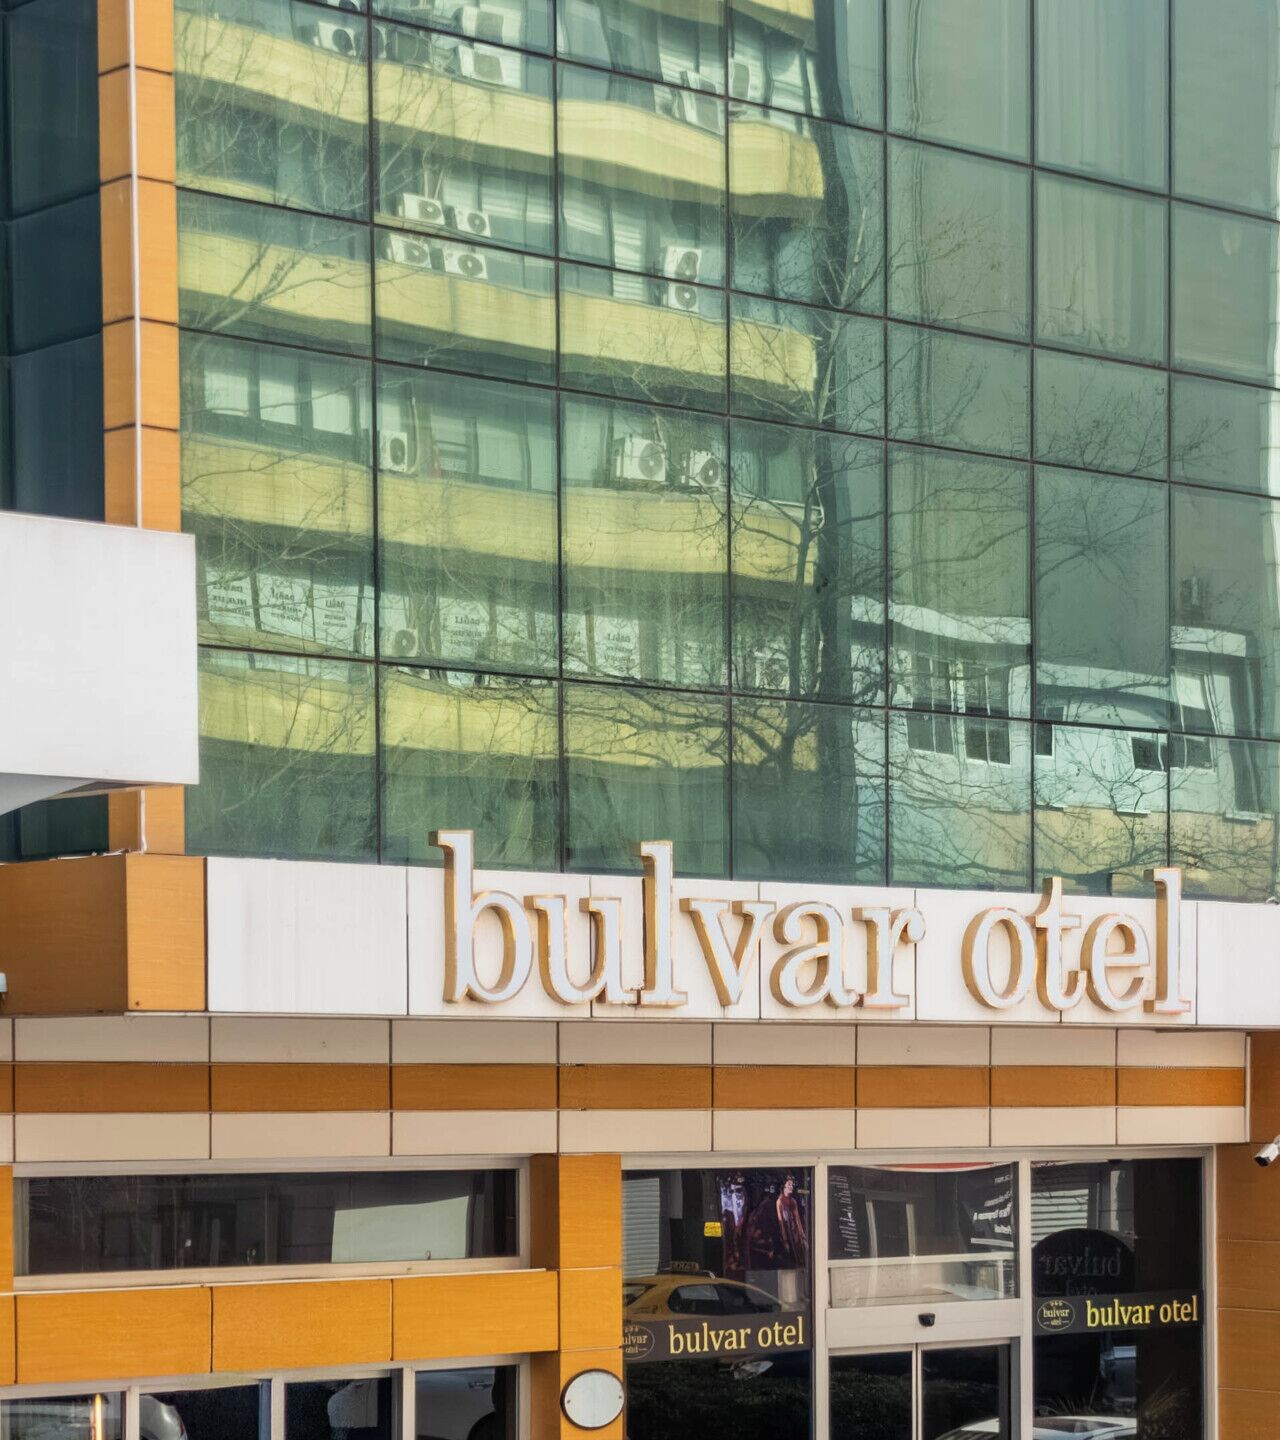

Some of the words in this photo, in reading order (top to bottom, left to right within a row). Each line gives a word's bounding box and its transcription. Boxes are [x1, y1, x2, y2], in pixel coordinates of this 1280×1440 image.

[429, 829, 926, 1008] bulvar
[961, 867, 1191, 1013] otel
[1086, 1298, 1155, 1327] bulvar
[1159, 1295, 1198, 1323] otel
[622, 1333, 648, 1345] ulvar
[669, 1322, 751, 1354] bulvar
[757, 1316, 804, 1348] otel
